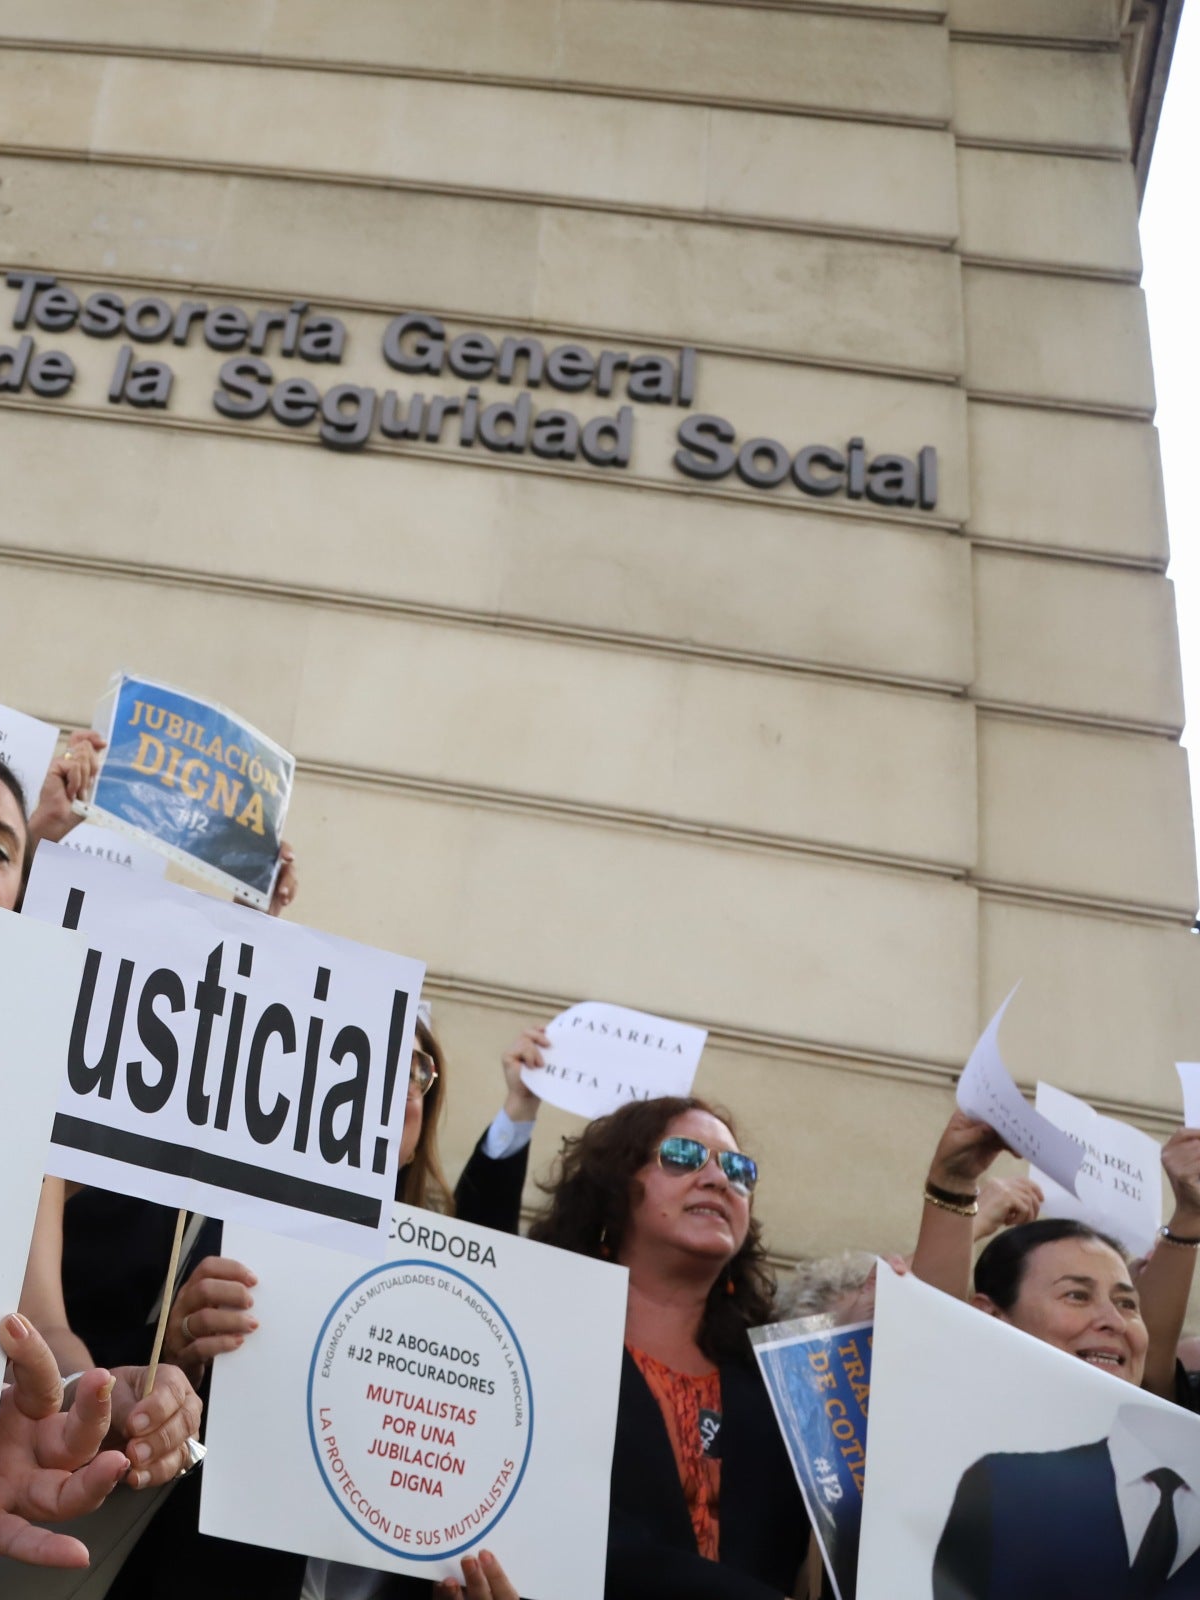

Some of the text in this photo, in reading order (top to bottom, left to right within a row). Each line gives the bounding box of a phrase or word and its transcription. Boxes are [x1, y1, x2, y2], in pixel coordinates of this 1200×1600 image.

[6, 271, 697, 408] Tesorería General
[107, 344, 176, 410] la
[212, 355, 634, 469] Seguridad
[673, 412, 939, 512] Social
[127, 699, 281, 798] JUBILACIÓN
[130, 731, 266, 837] DIGNA
[177, 808, 210, 834] #J2
[62, 887, 410, 1176] usticia!
[350, 1295, 368, 1315] LAS
[366, 1273, 436, 1300] MUTUALIDADES
[437, 1278, 451, 1292] DE
[451, 1284, 464, 1300] LA
[344, 1312, 353, 1325] A
[320, 1321, 347, 1380] EXIGIMOS
[368, 1324, 481, 1369] #J2 ABOGADOS
[501, 1341, 509, 1352] Y
[504, 1352, 515, 1370] LA
[346, 1344, 496, 1396] #J2 PROCURADORES
[807, 1350, 838, 1393] DE
[365, 1383, 478, 1427] MUTUALISTAS
[510, 1369, 524, 1429] PROCURA
[381, 1414, 457, 1448] POR UNA
[318, 1406, 516, 1546] LA PROTECCIÓN DE SUS MUTUALISTAS
[367, 1437, 467, 1476] JUBILACIÓN
[389, 1470, 444, 1498] DIGNA
[813, 1455, 845, 1504] #J2
